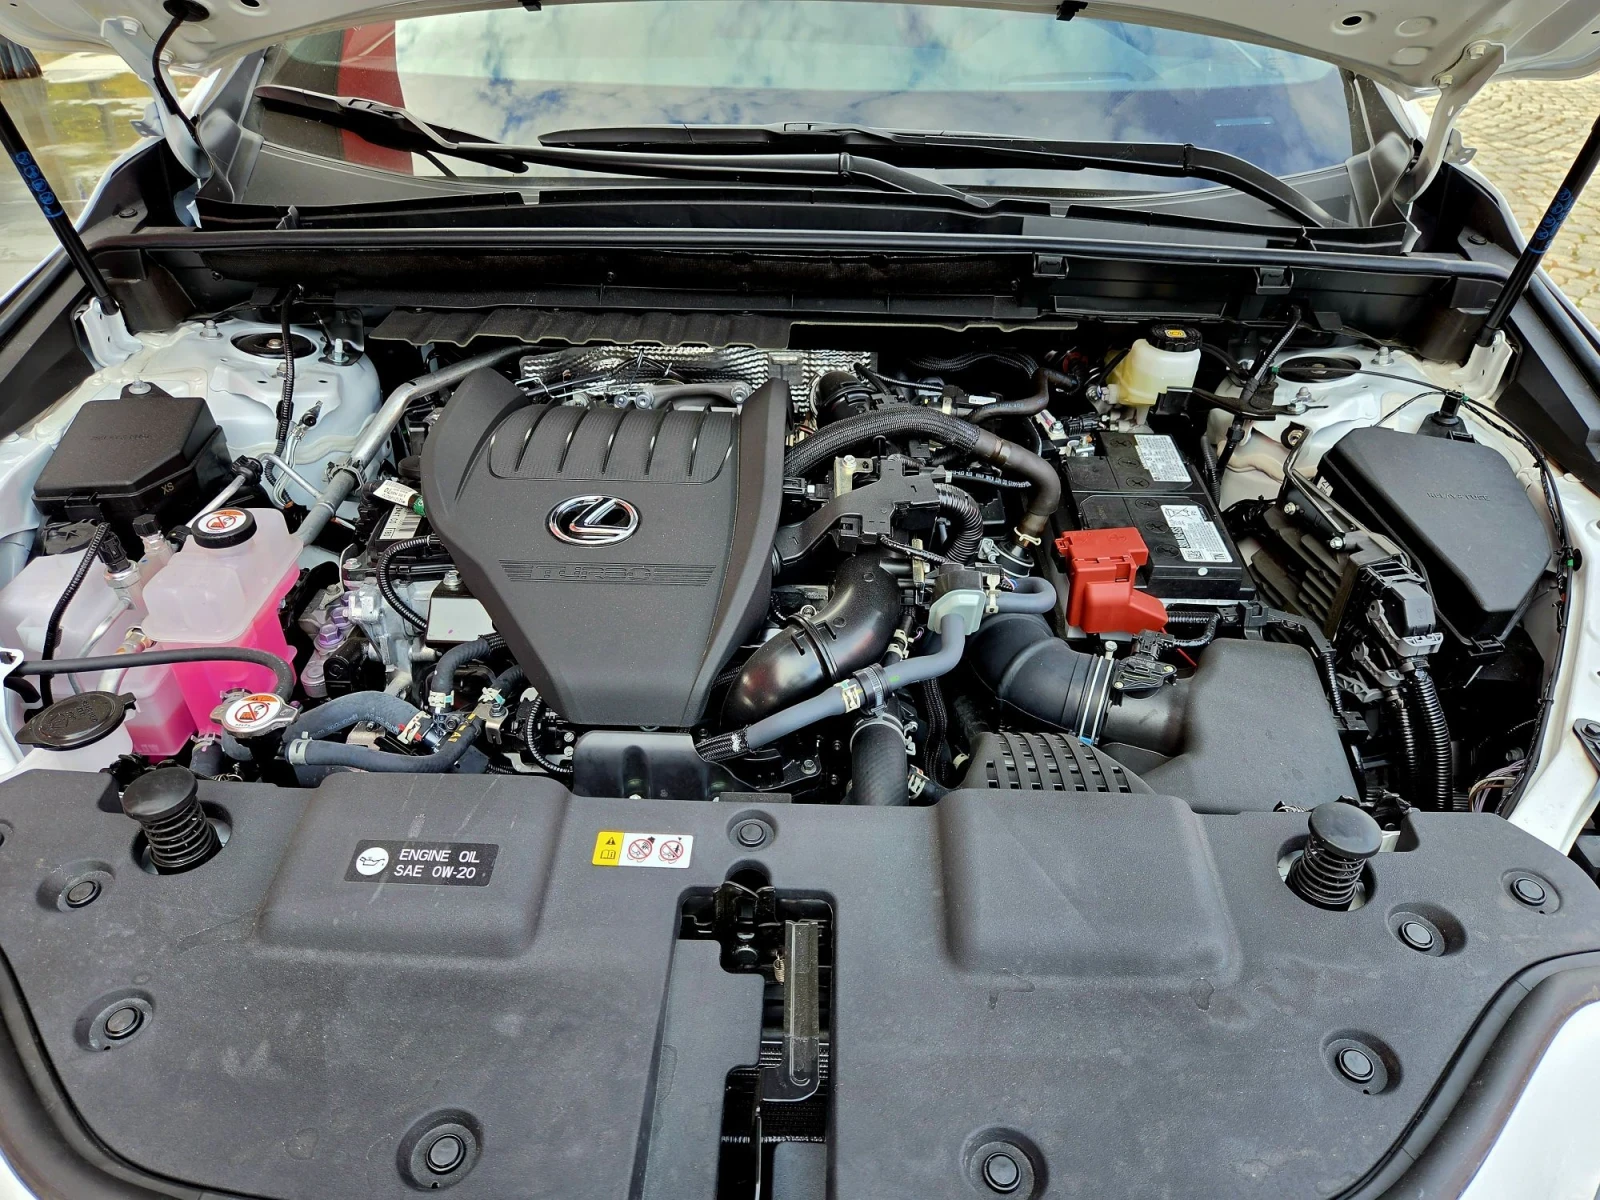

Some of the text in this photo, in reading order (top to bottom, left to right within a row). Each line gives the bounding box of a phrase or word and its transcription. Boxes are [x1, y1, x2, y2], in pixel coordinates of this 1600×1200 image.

[535, 566, 652, 580] TURBO
[399, 849, 480, 863] ENGINE OIL
[394, 865, 476, 879] SAE 0W-20
